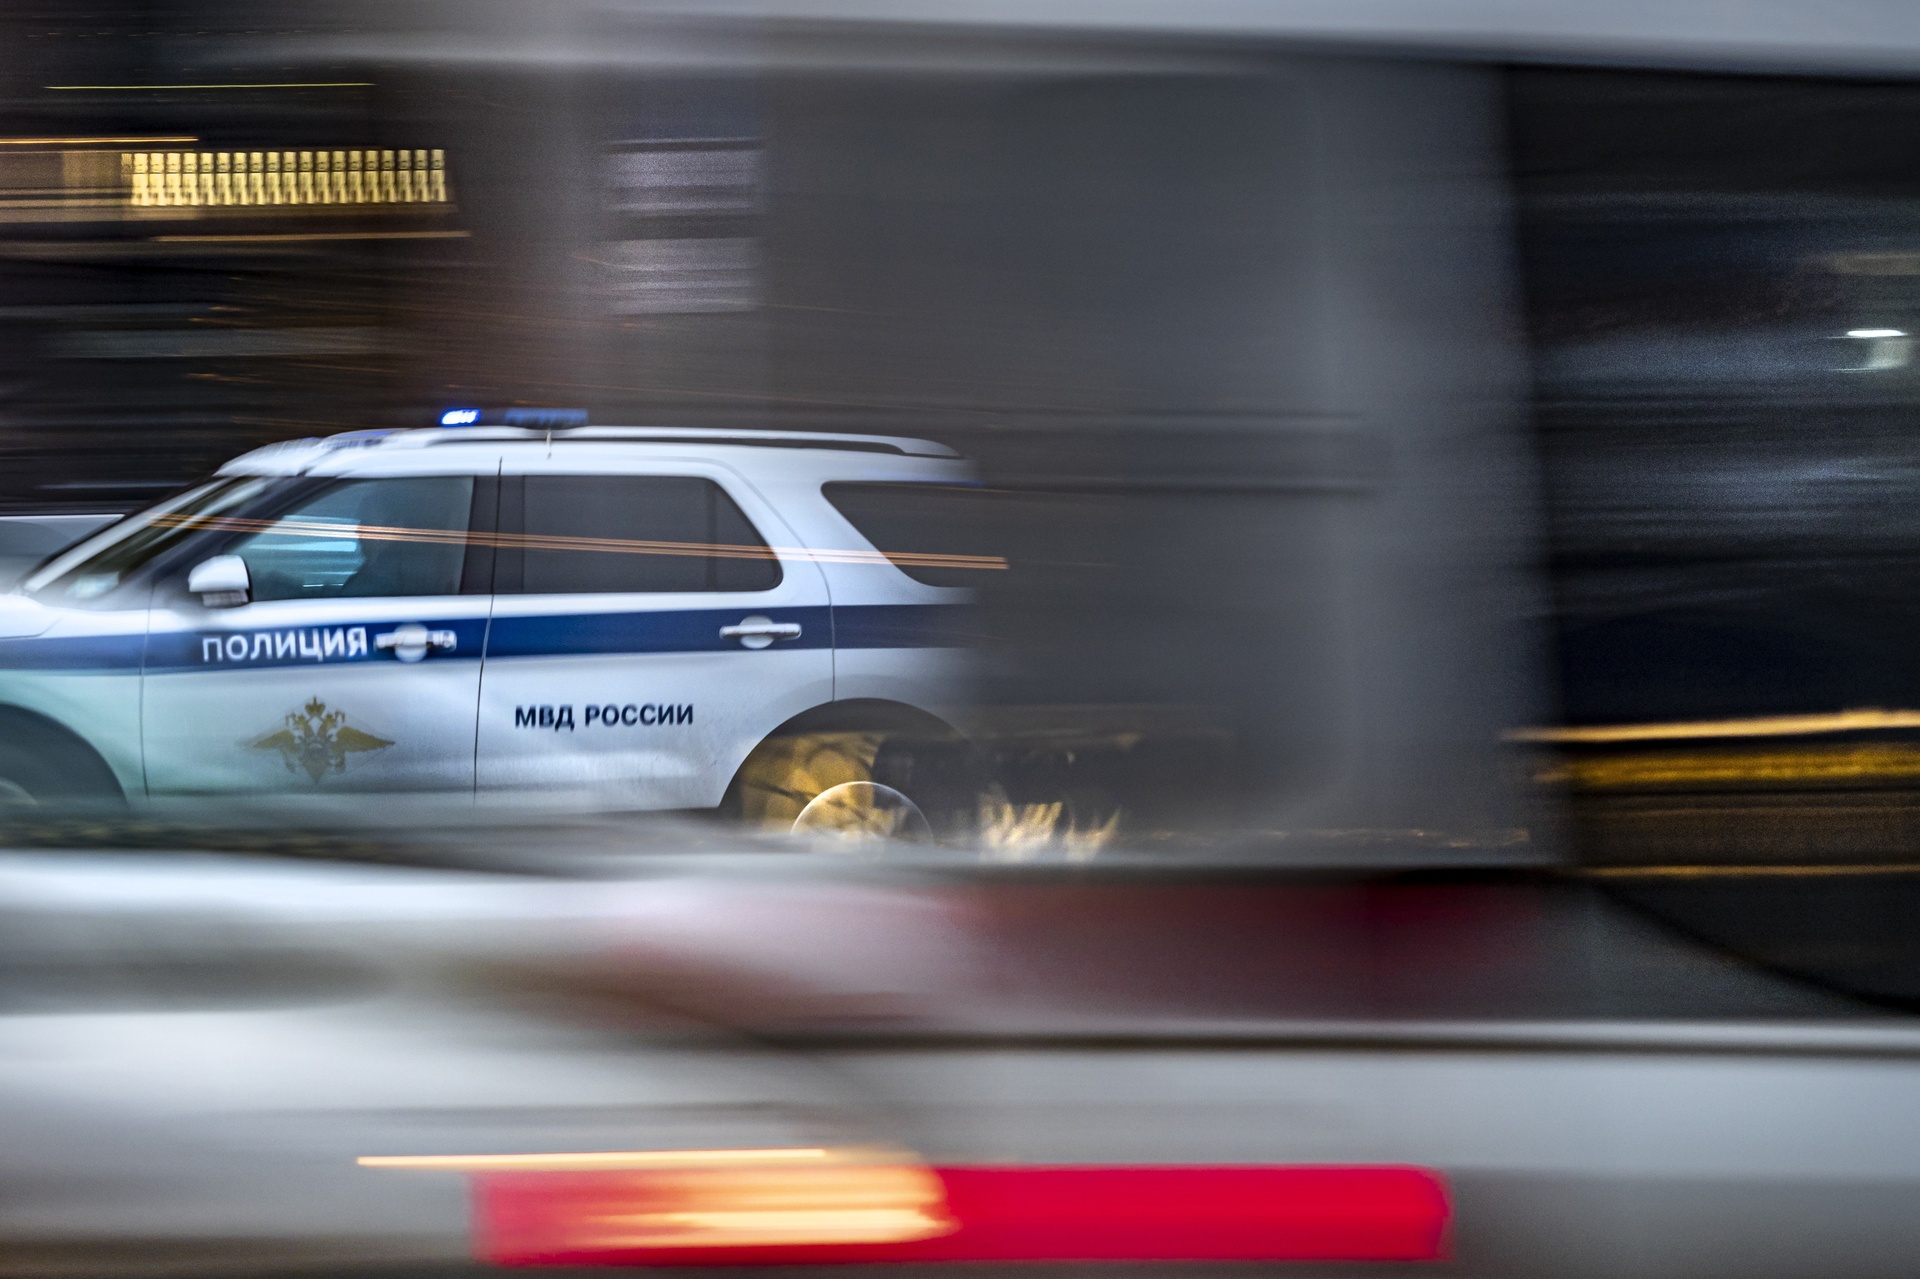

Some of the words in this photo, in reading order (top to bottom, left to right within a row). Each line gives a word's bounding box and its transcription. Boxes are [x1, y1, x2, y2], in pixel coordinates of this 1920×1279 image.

[202, 626, 368, 662] ПОЛИЦИЯ
[514, 704, 575, 732] МВД
[585, 703, 694, 727] РОССИИ
